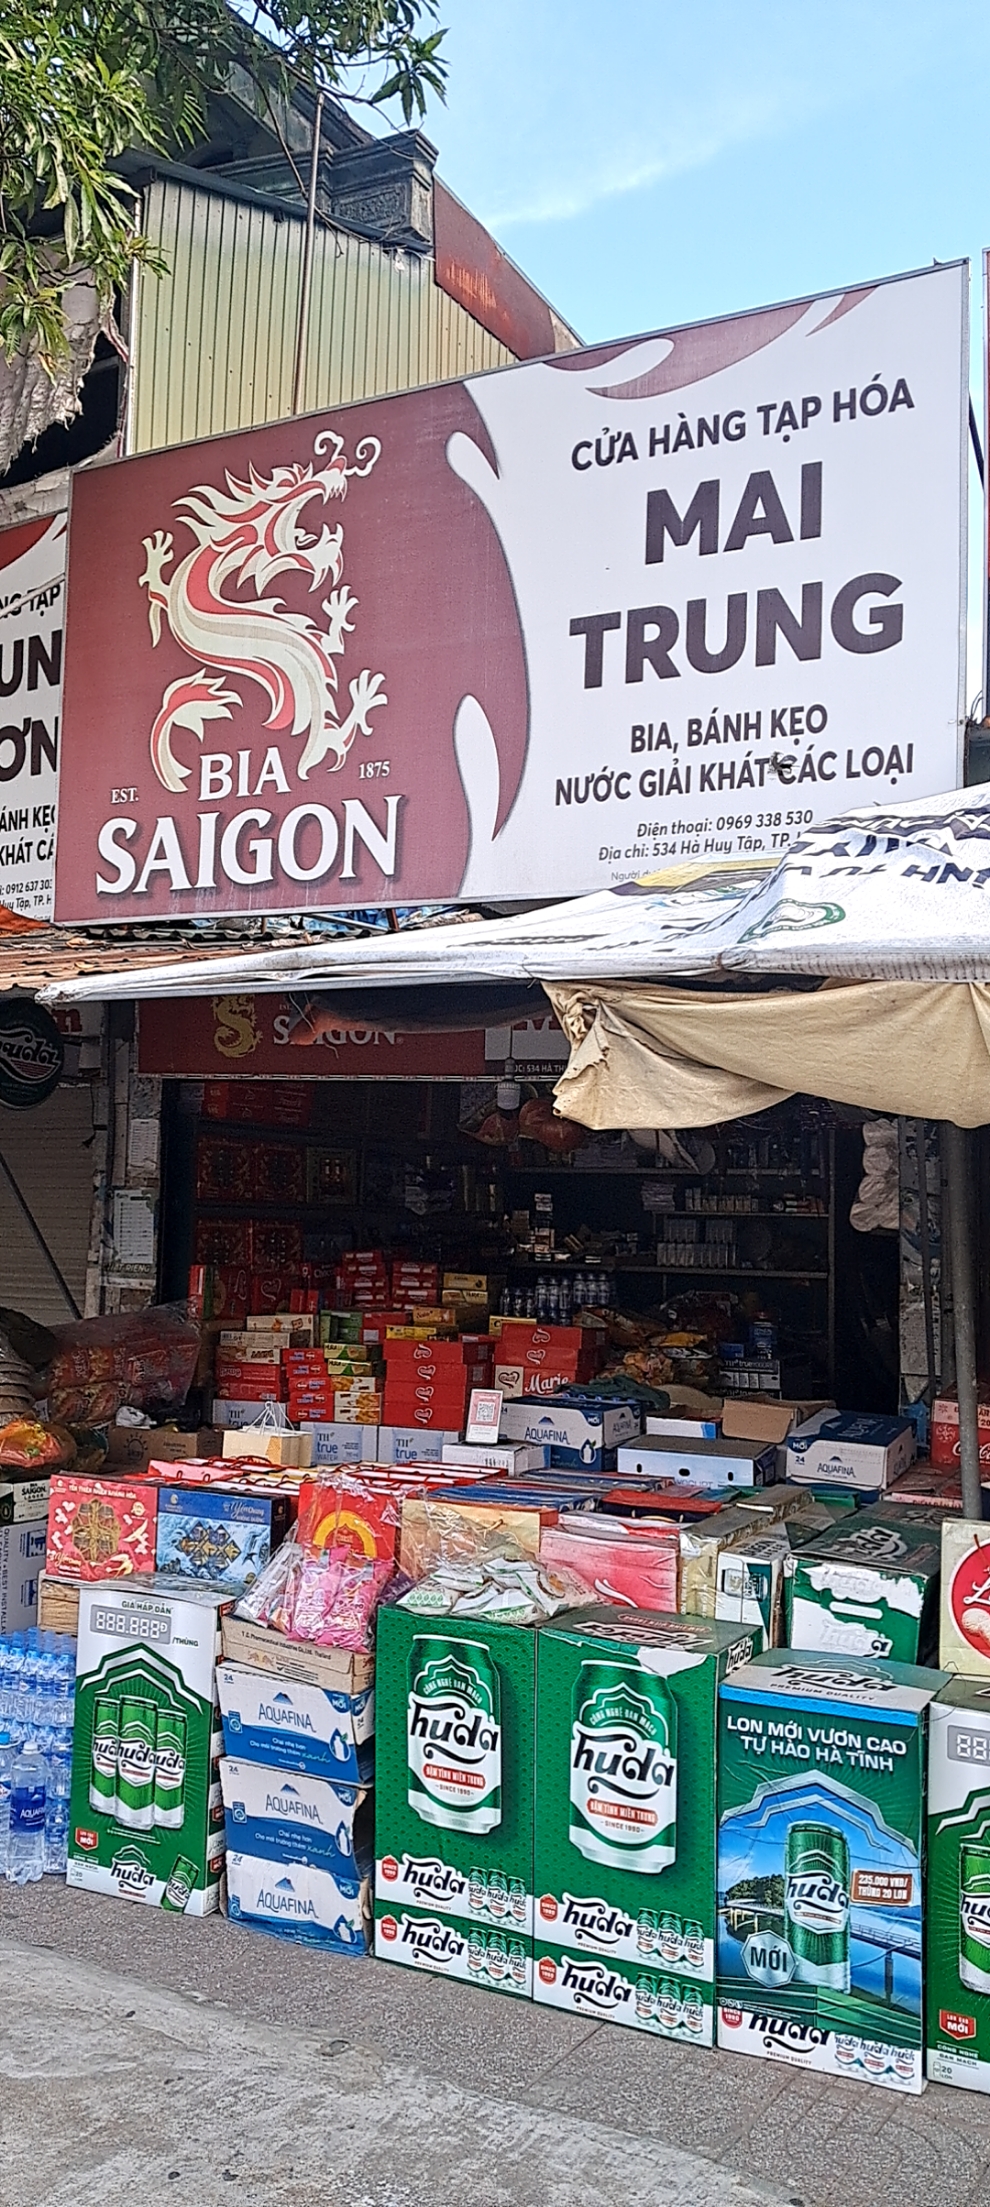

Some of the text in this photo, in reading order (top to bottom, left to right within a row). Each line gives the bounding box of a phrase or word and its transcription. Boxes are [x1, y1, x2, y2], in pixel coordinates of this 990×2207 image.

[571, 373, 915, 471] CỬA HÀNG TẠP HÓA
[645, 461, 823, 565] MAI
[569, 572, 904, 689] TRUNG
[630, 704, 828, 754] BIA, BÁNH KẸO
[198, 747, 292, 801] BIA
[358, 761, 391, 779] 1875
[555, 743, 915, 806] NƯỚC GIẢI KHÁT CÁC LOẠI
[111, 787, 139, 804] EST.
[637, 809, 814, 842] Điện thoại: 0969 338 530
[96, 794, 403, 895] SAIGON
[599, 846, 621, 865] Địa
[624, 842, 650, 860] chỉ:
[652, 842, 677, 857] 534
[680, 838, 700, 855] Hà
[704, 836, 732, 855] Huy
[736, 834, 766, 852] Tập,
[771, 833, 791, 848] TP.
[6, 883, 24, 896] 0912
[317, 1441, 338, 1454] true
[525, 1427, 570, 1446] AQUAFINA
[396, 1448, 418, 1460] true
[817, 1462, 857, 1478] AQUAFINA
[22, 1486, 48, 1495] SAIGON
[122, 1600, 135, 1610] GIÁ
[224, 1673, 233, 1682] 24
[771, 1664, 898, 1692] huda
[770, 1683, 876, 1701] PREMIUM QUALITY
[258, 1703, 317, 1733] AQUAFINA
[410, 1699, 499, 1752] huda
[727, 1715, 907, 1755] LON MỚI VƯƠN CAO
[574, 1729, 675, 1787] huda
[740, 1735, 894, 1772] TỰ HÀO HÀ TĨNH
[229, 1765, 239, 1773] 24
[440, 1784, 456, 1792] SINCE
[266, 1794, 324, 1825] AQUAFINA
[604, 1820, 640, 1833] SINCE 1990
[232, 1854, 243, 1863] 24
[111, 1859, 155, 1886] huda
[403, 1857, 466, 1896] huda
[256, 1889, 319, 1918] AQUAFINA
[541, 1902, 557, 1911] SINCE
[882, 1889, 892, 1899] 20
[893, 1890, 907, 1900] LON
[562, 1897, 633, 1937] huda
[402, 1917, 464, 1956] huda
[540, 1965, 556, 1973] SINCE
[751, 1945, 787, 1973] MỚI
[561, 1960, 632, 2002] huda
[725, 2013, 741, 2022] 1990
[947, 2021, 968, 2034] MỚI
[766, 2051, 812, 2066] PREMIUM QUALITY
[941, 2065, 953, 2074] 20
